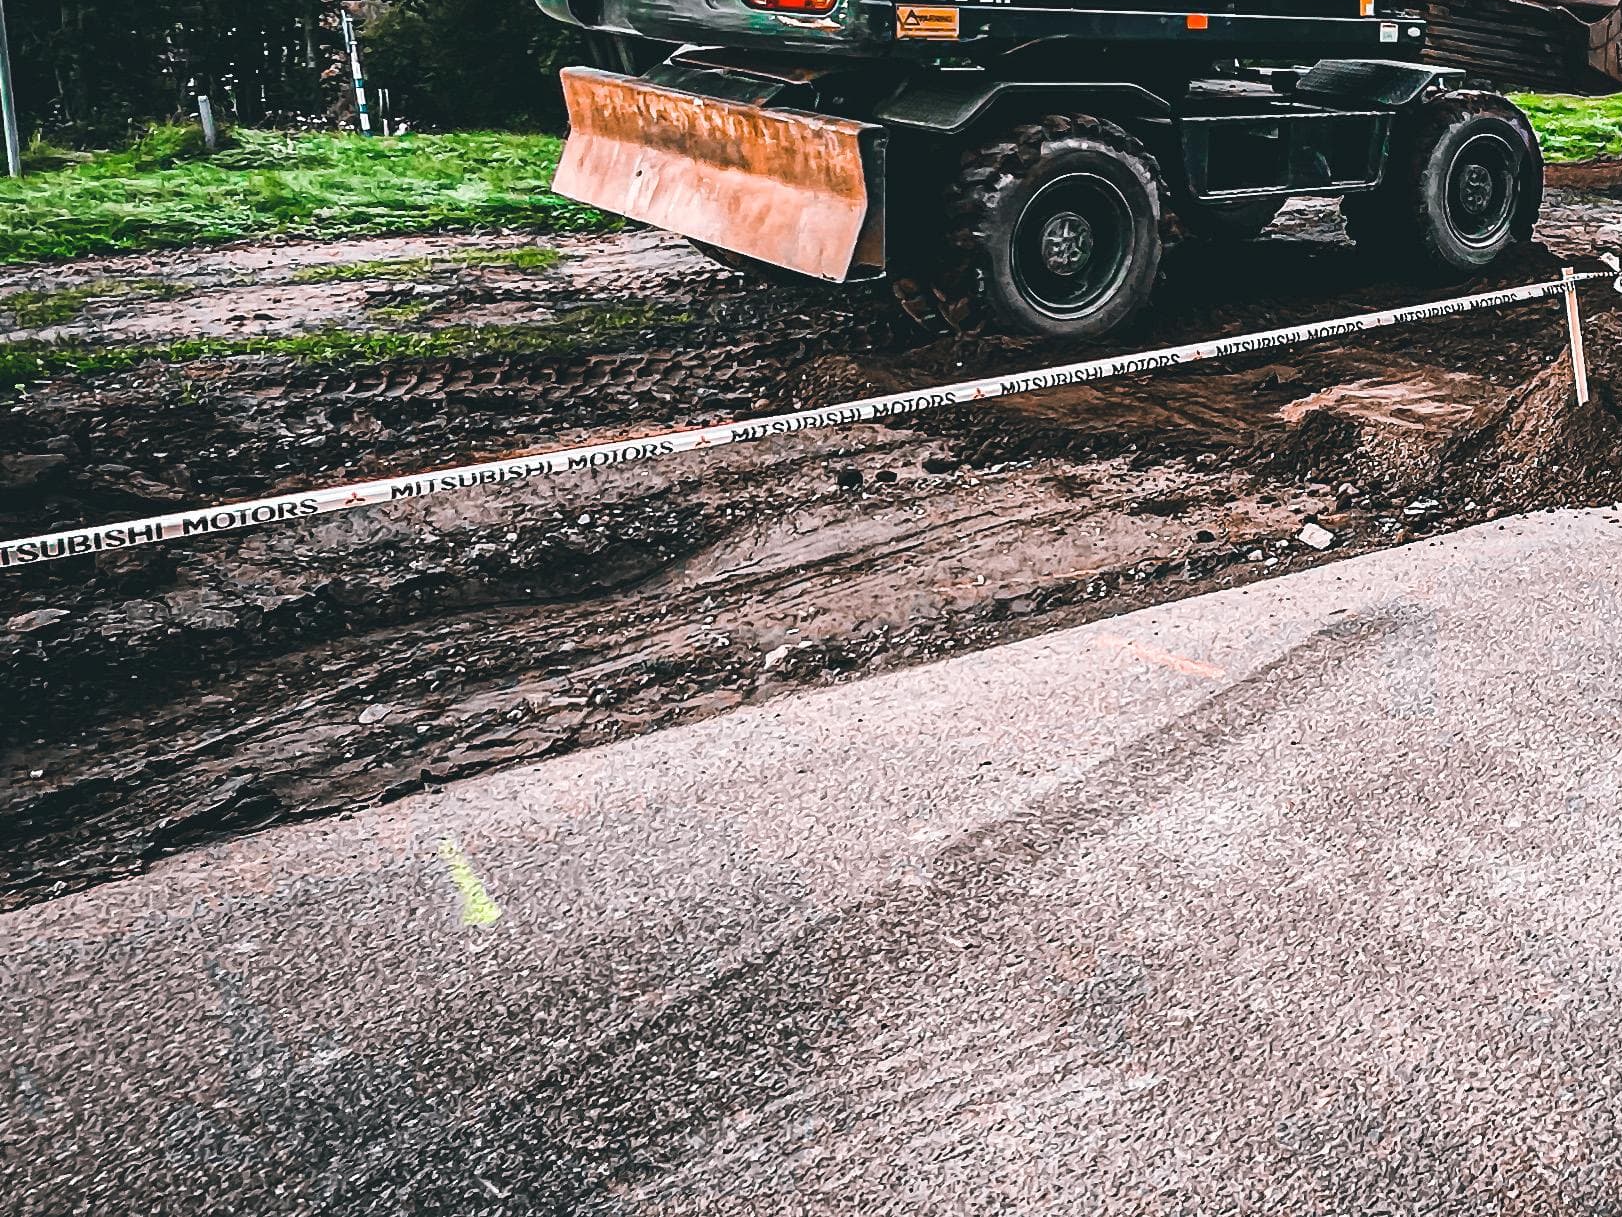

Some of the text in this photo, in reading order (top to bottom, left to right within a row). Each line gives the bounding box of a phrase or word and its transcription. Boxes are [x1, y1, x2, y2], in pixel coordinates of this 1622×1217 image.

[731, 392, 957, 443] MITSUBISHI MOTORS
[391, 440, 674, 500] MITSUBISHI MOTORS
[183, 498, 319, 535] MOTORS
